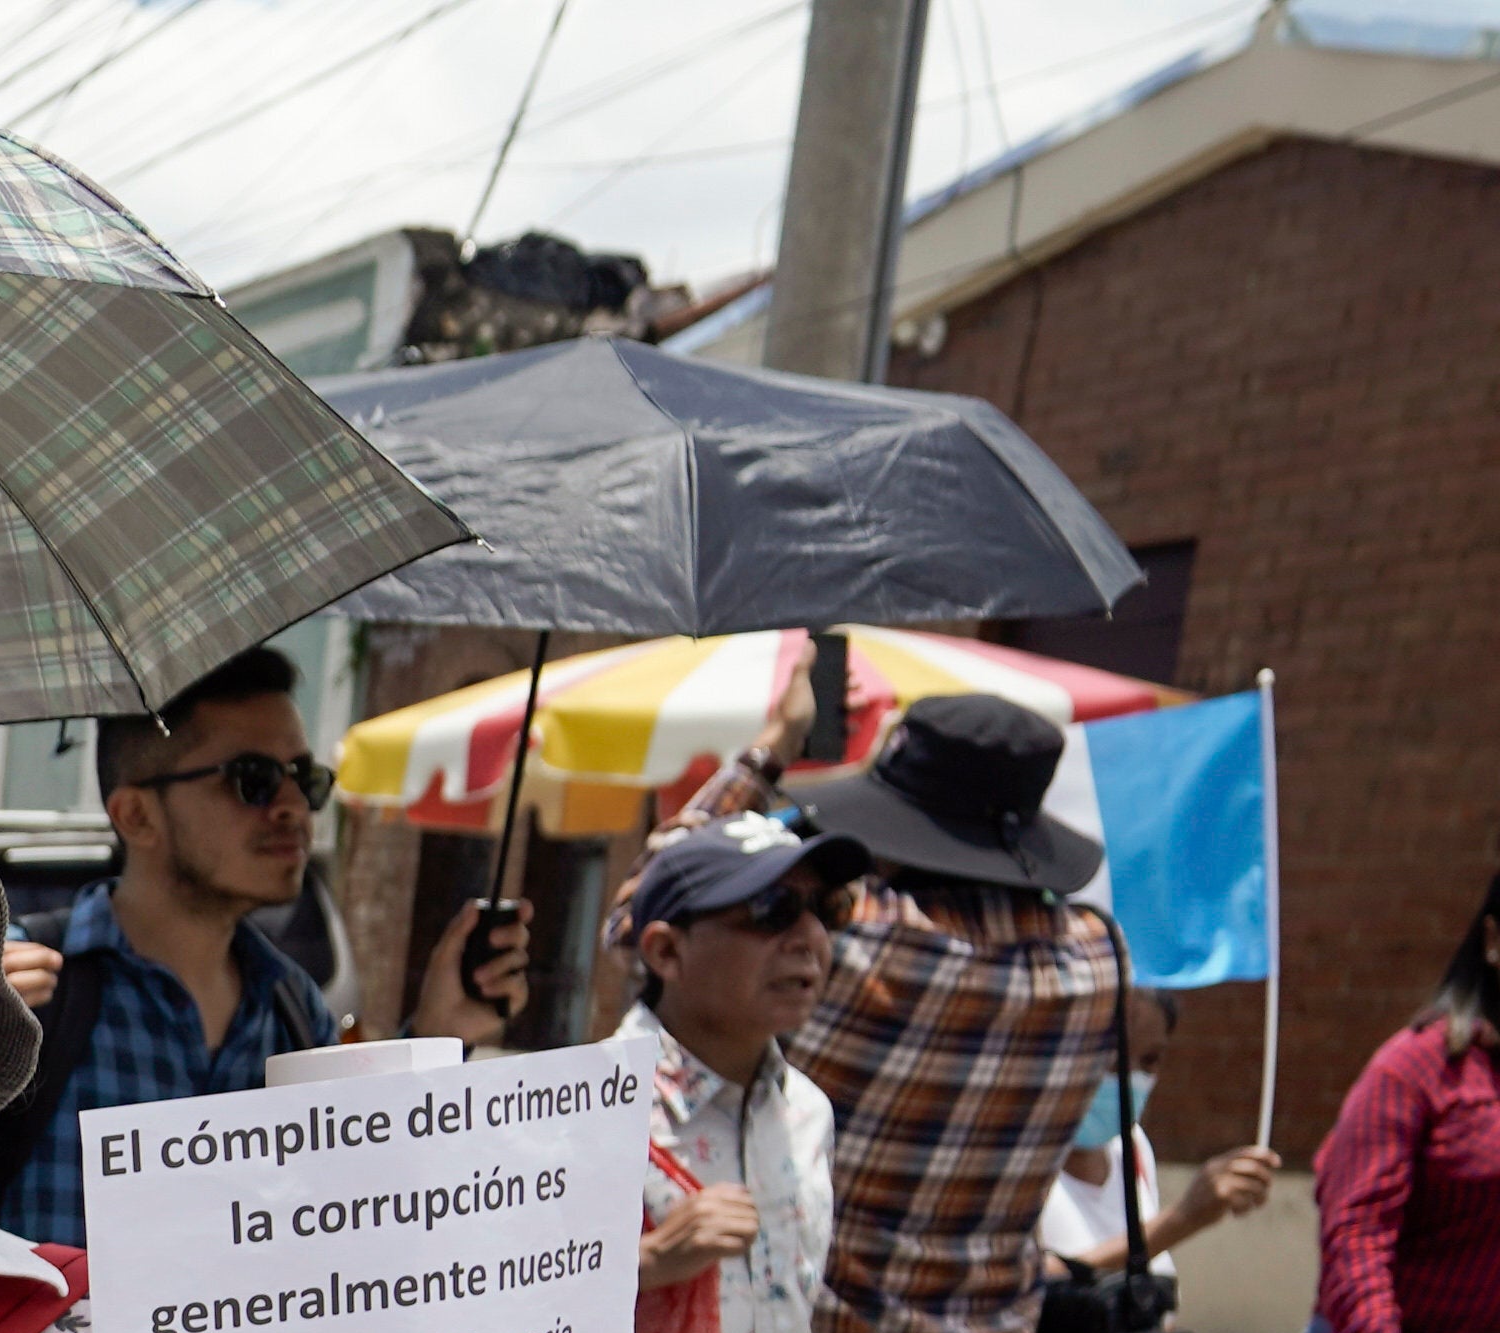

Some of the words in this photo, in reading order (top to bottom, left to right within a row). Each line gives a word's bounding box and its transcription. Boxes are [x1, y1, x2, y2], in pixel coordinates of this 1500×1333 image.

[101, 1129, 141, 1177] El
[160, 1105, 392, 1167] cómplice
[407, 1087, 473, 1139] del
[486, 1079, 592, 1129] crimen
[600, 1064, 639, 1107] de
[231, 1201, 274, 1244] la
[291, 1166, 526, 1238] corrupción
[535, 1163, 567, 1200] es
[498, 1238, 604, 1291] nuestra
